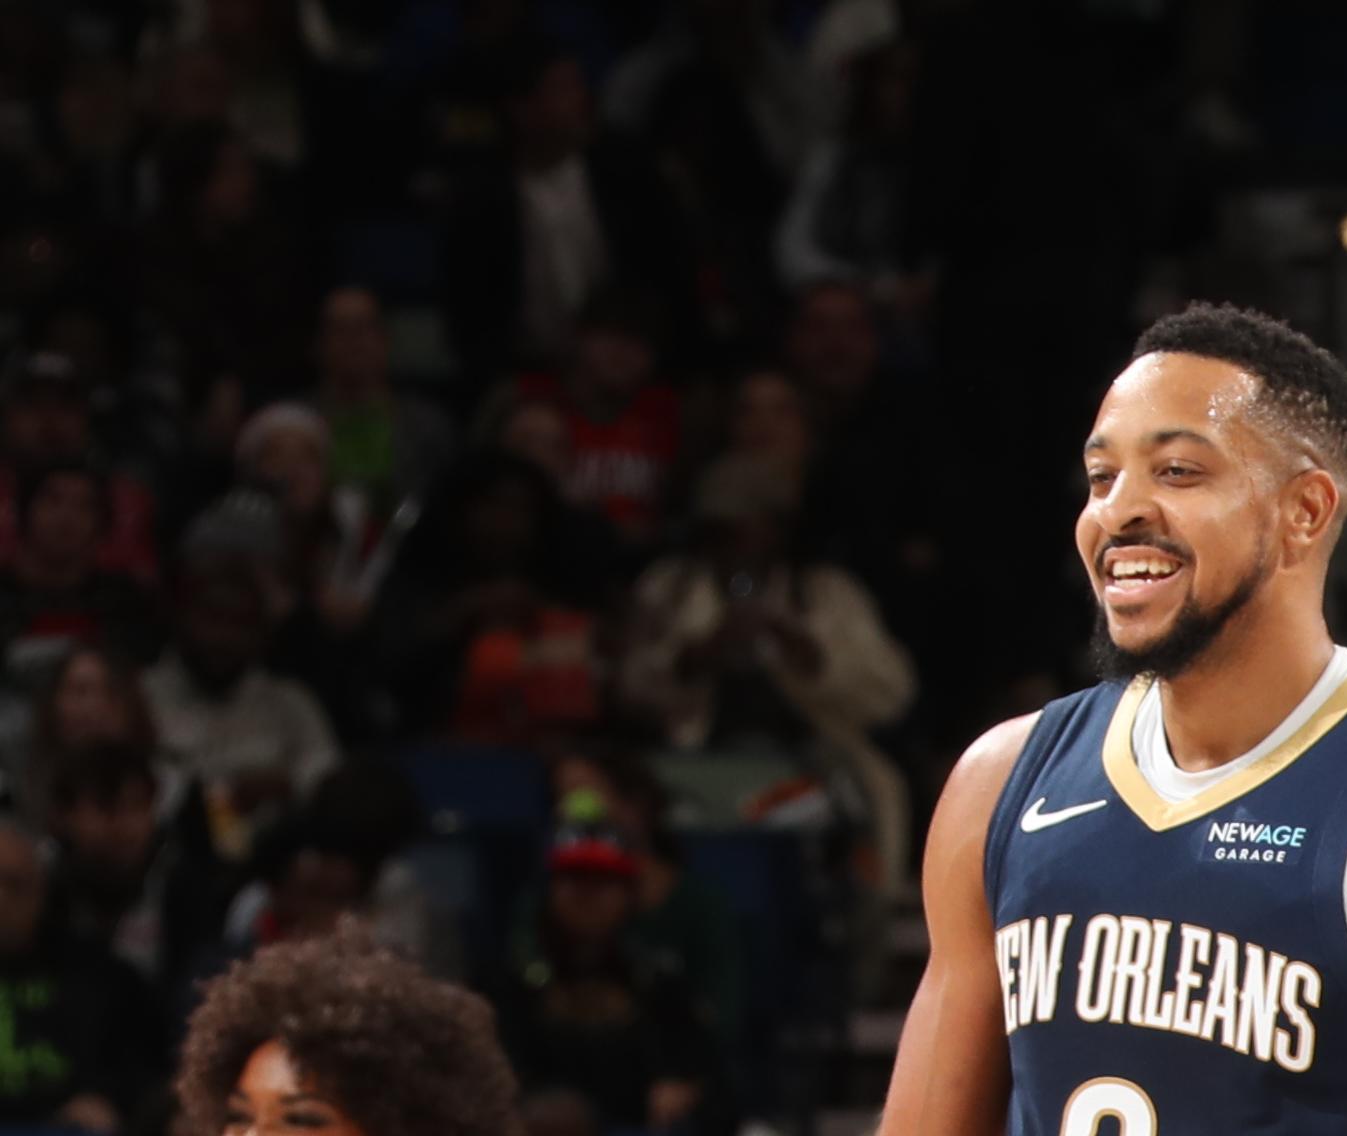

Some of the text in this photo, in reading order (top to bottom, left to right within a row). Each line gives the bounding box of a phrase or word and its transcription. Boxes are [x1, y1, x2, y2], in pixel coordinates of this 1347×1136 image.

[1207, 822, 1306, 847] NEWAGE
[1214, 847, 1286, 863] GARAGE
[1075, 914, 1321, 1073] ORLEANS
